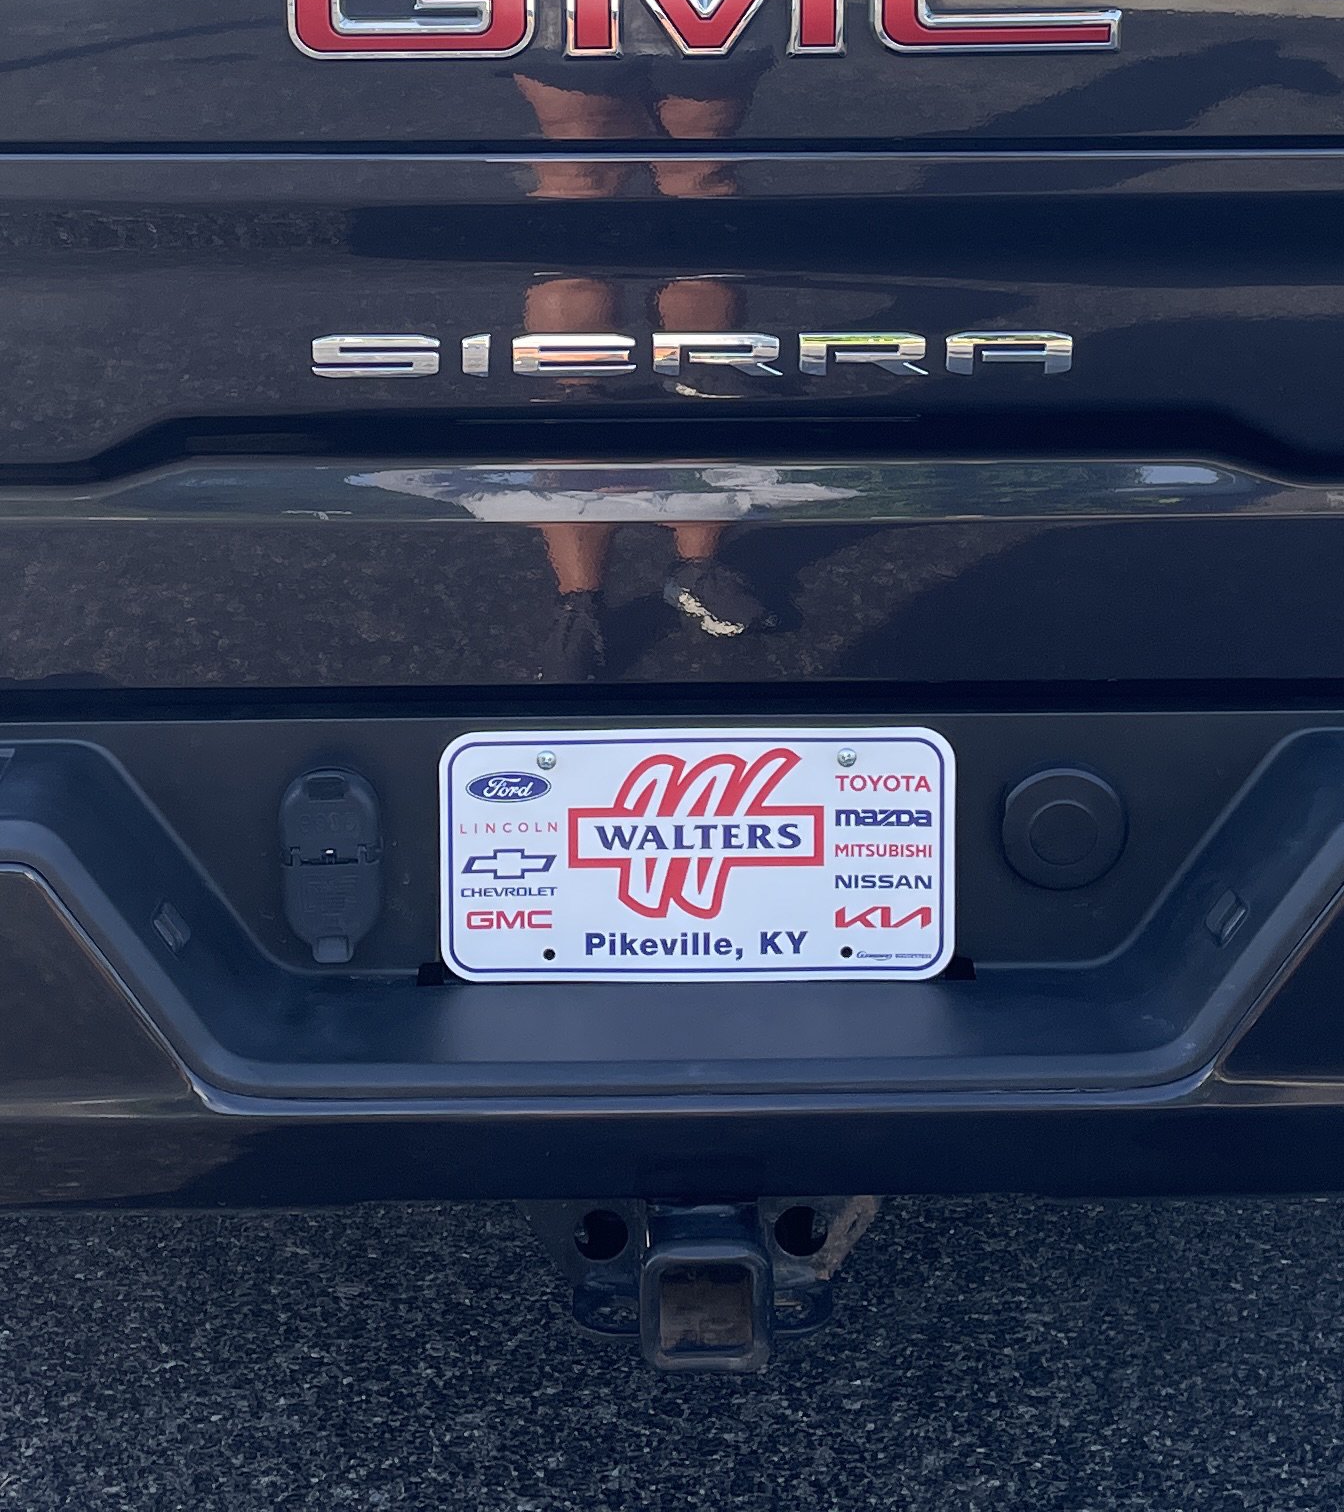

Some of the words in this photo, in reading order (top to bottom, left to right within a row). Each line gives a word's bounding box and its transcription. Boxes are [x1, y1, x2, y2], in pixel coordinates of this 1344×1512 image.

[311, 329, 1075, 379] SIERRA
[482, 776, 534, 798] Ford
[834, 775, 932, 793] TOYOTA
[459, 822, 559, 834] LINCOLN
[593, 823, 803, 851] WALTERS
[834, 843, 932, 859] MITSUBISHI
[834, 874, 933, 890] NISSAN
[460, 887, 558, 898] CHEVROLET
[466, 910, 553, 930] GMC
[834, 905, 932, 929] KIA
[585, 931, 744, 960] Pikeville,
[760, 931, 809, 956] KY
